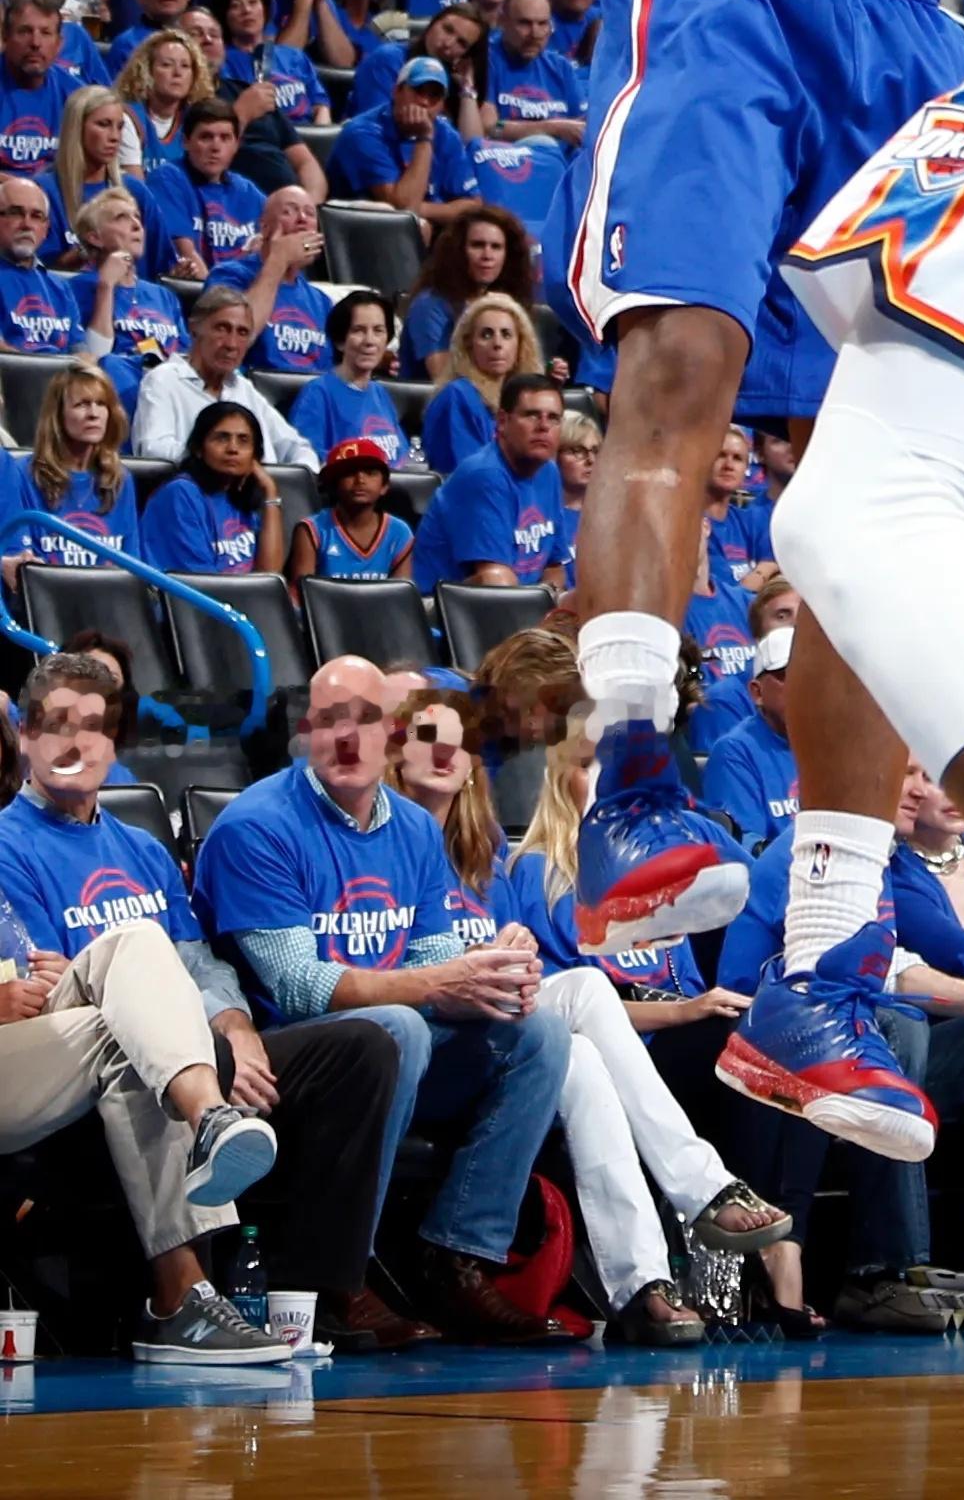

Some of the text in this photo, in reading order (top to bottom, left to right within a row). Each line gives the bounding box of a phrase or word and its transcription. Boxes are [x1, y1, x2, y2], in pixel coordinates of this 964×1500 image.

[0, 135, 58, 150] KLAHOM
[348, 932, 386, 956] CITY
[616, 947, 658, 969] CITY
